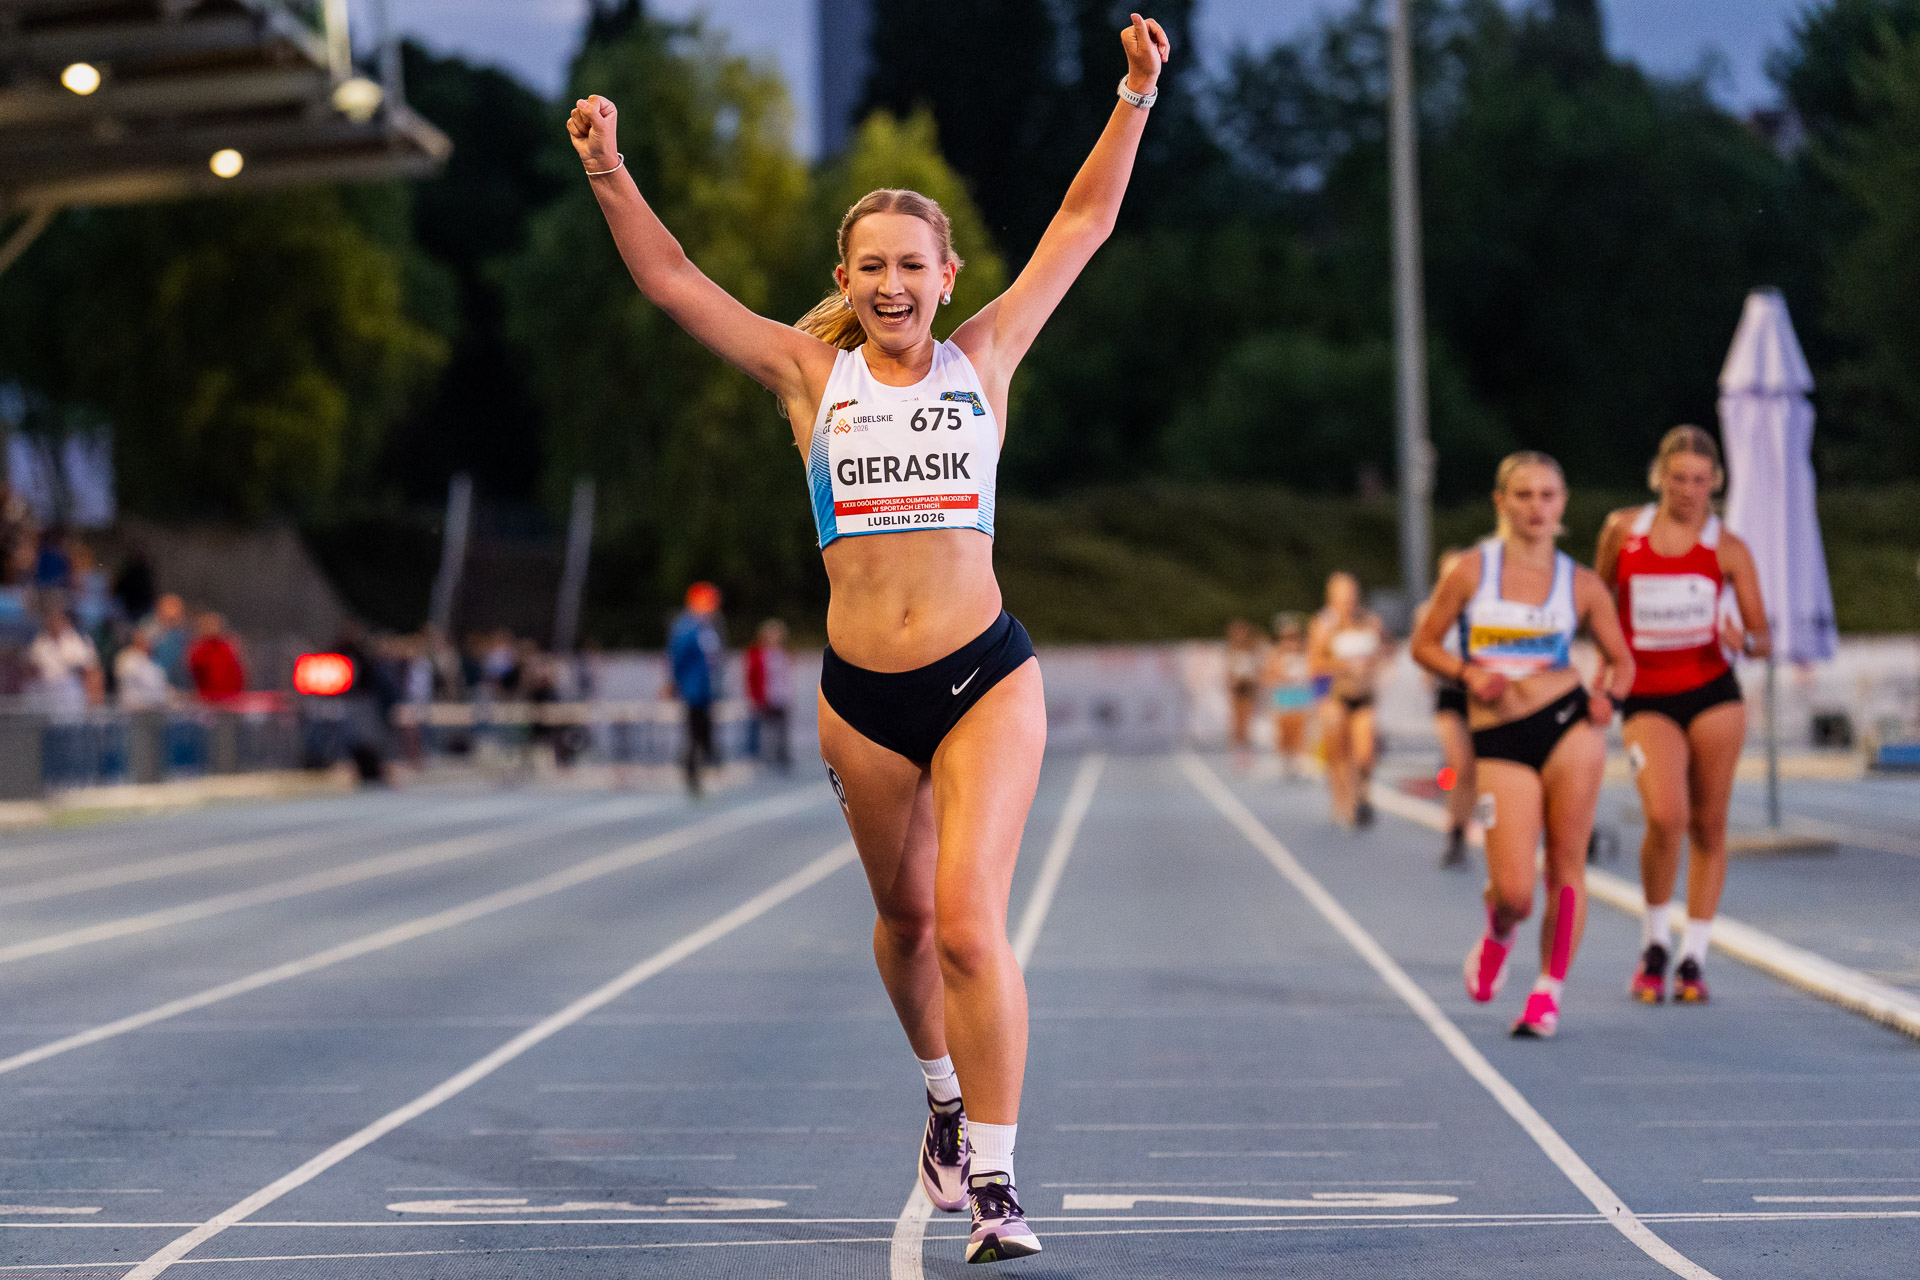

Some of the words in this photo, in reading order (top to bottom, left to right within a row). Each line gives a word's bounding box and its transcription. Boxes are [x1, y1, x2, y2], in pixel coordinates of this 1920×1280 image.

[853, 414, 893, 424] LUBELSKIE
[910, 407, 962, 432] 675
[837, 452, 971, 486] GIERASIK
[857, 499, 904, 507] OGÓLNOPOLSKA
[868, 515, 911, 526] LUBLIN
[914, 513, 945, 523] 2026
